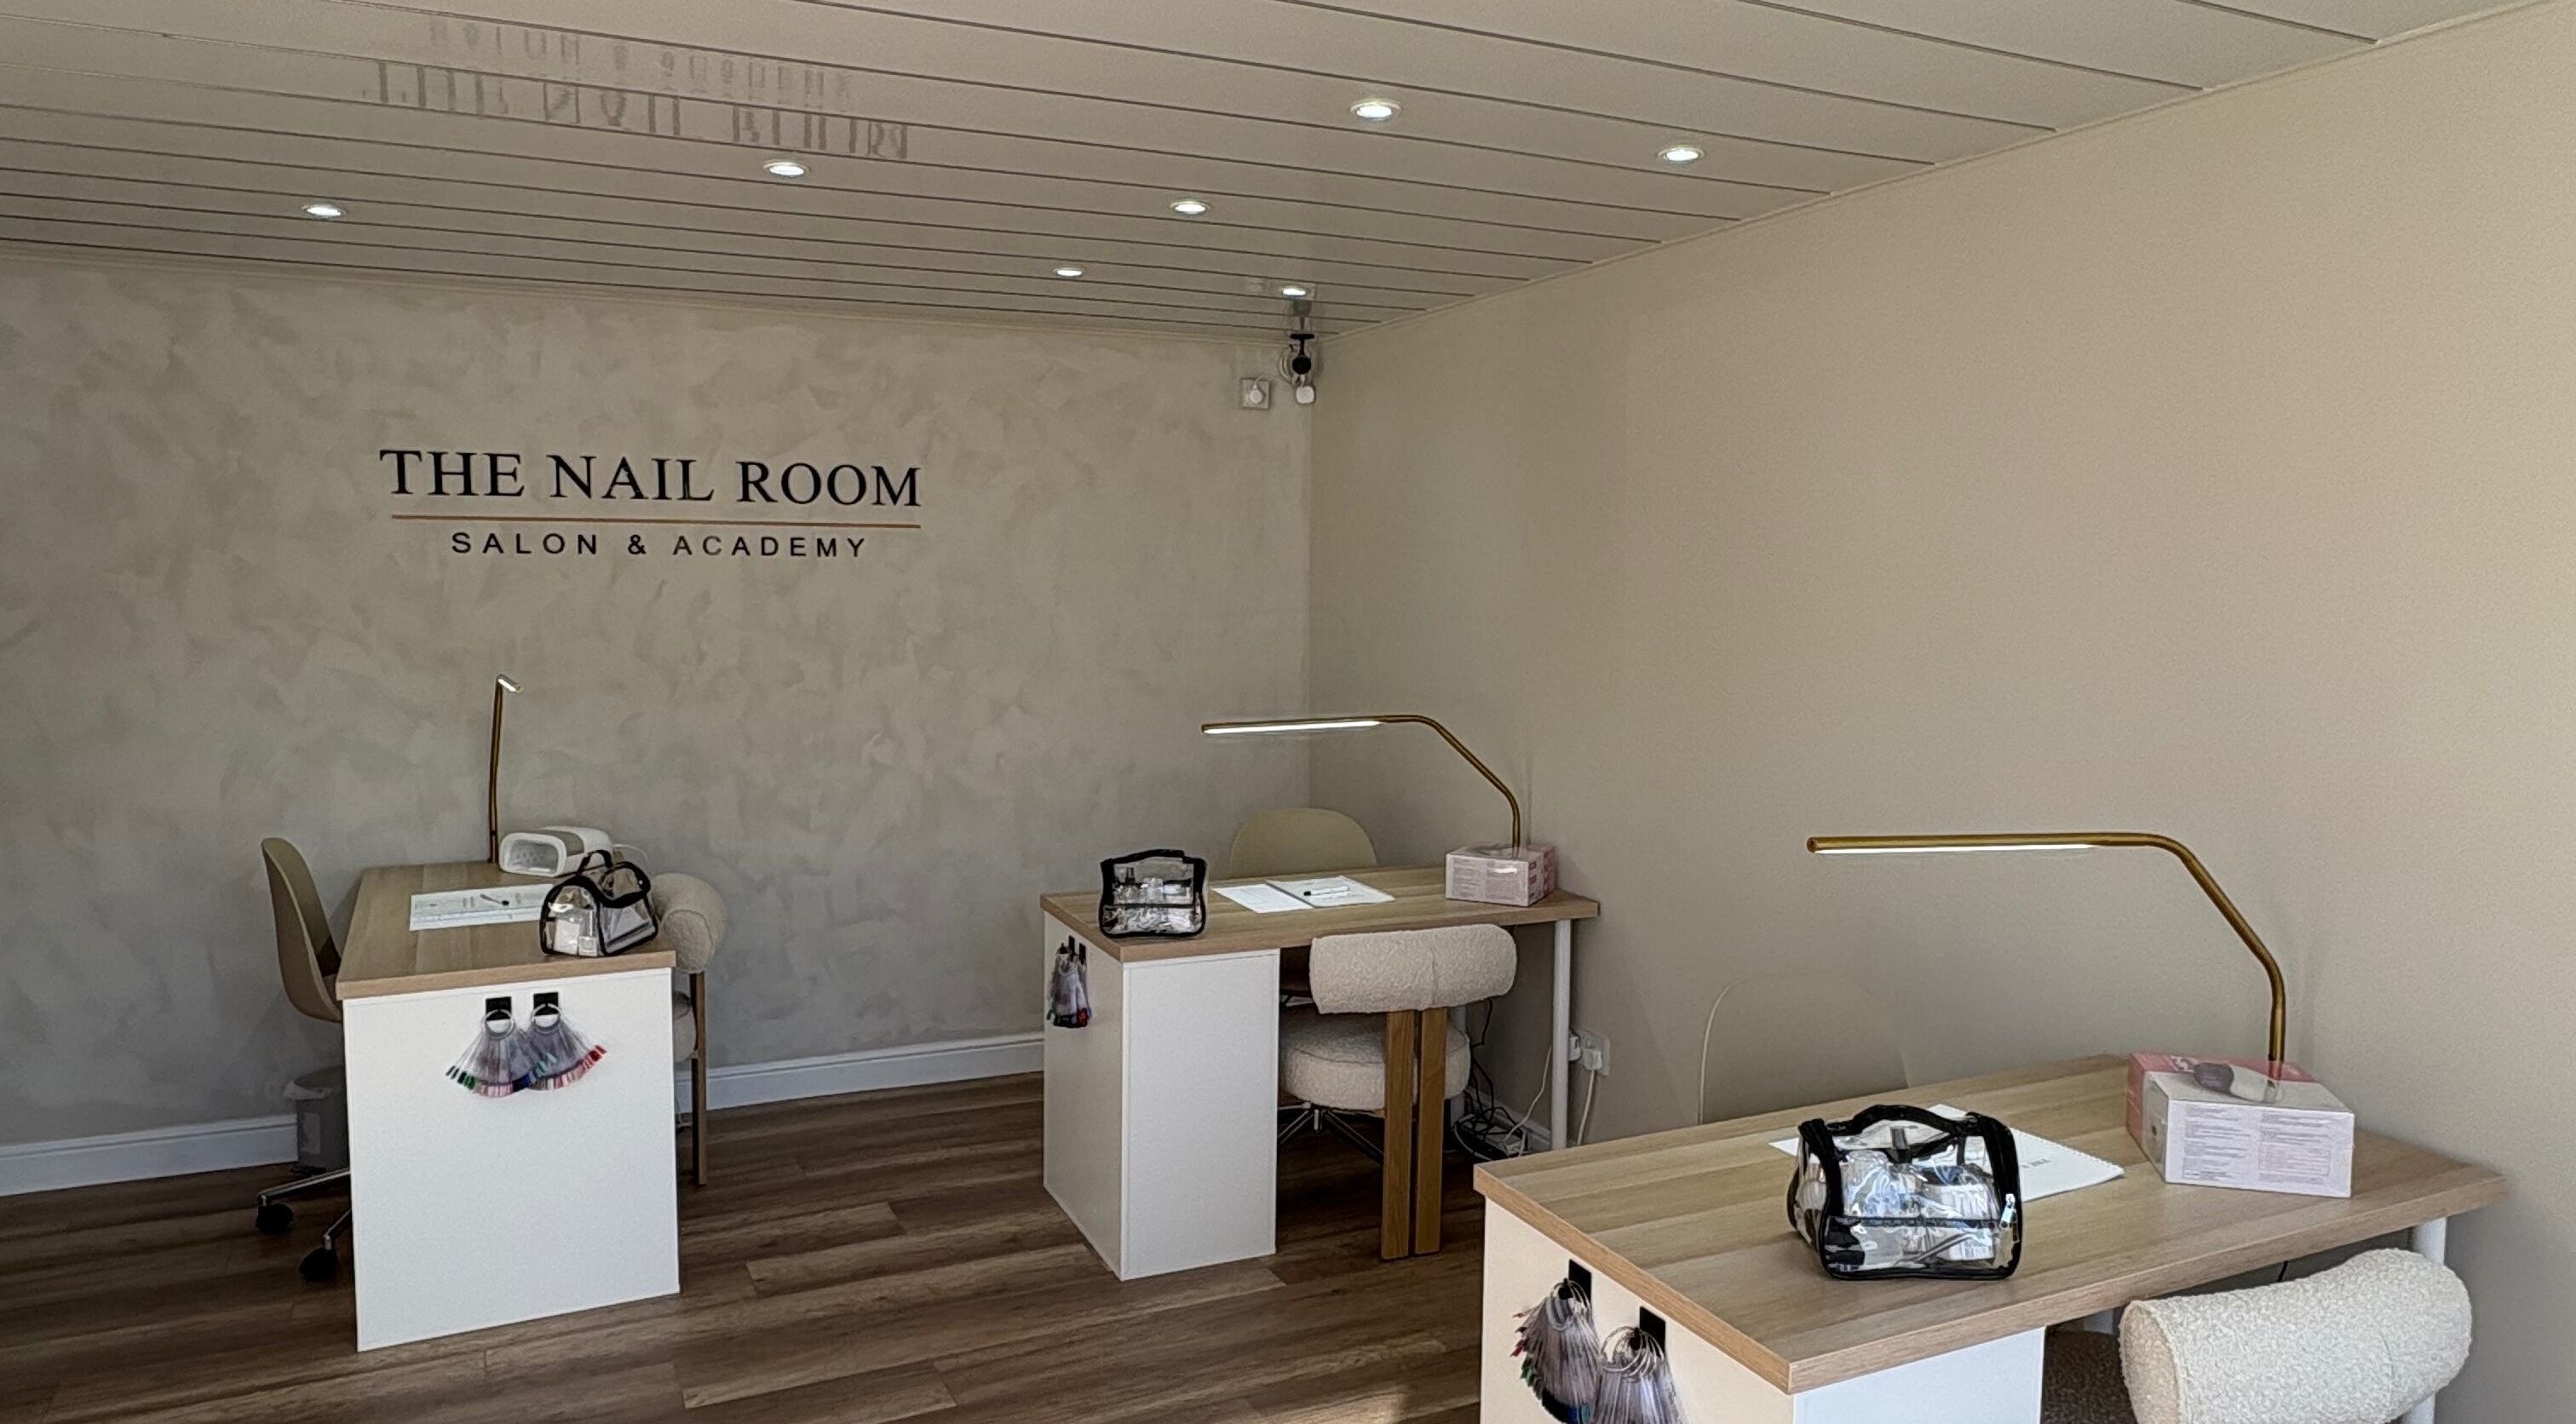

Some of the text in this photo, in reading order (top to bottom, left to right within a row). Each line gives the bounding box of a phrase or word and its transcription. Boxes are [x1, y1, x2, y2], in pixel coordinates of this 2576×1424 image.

[379, 449, 922, 508] THE NAIL ROOM
[451, 531, 865, 558] SALON & ACADEMY
